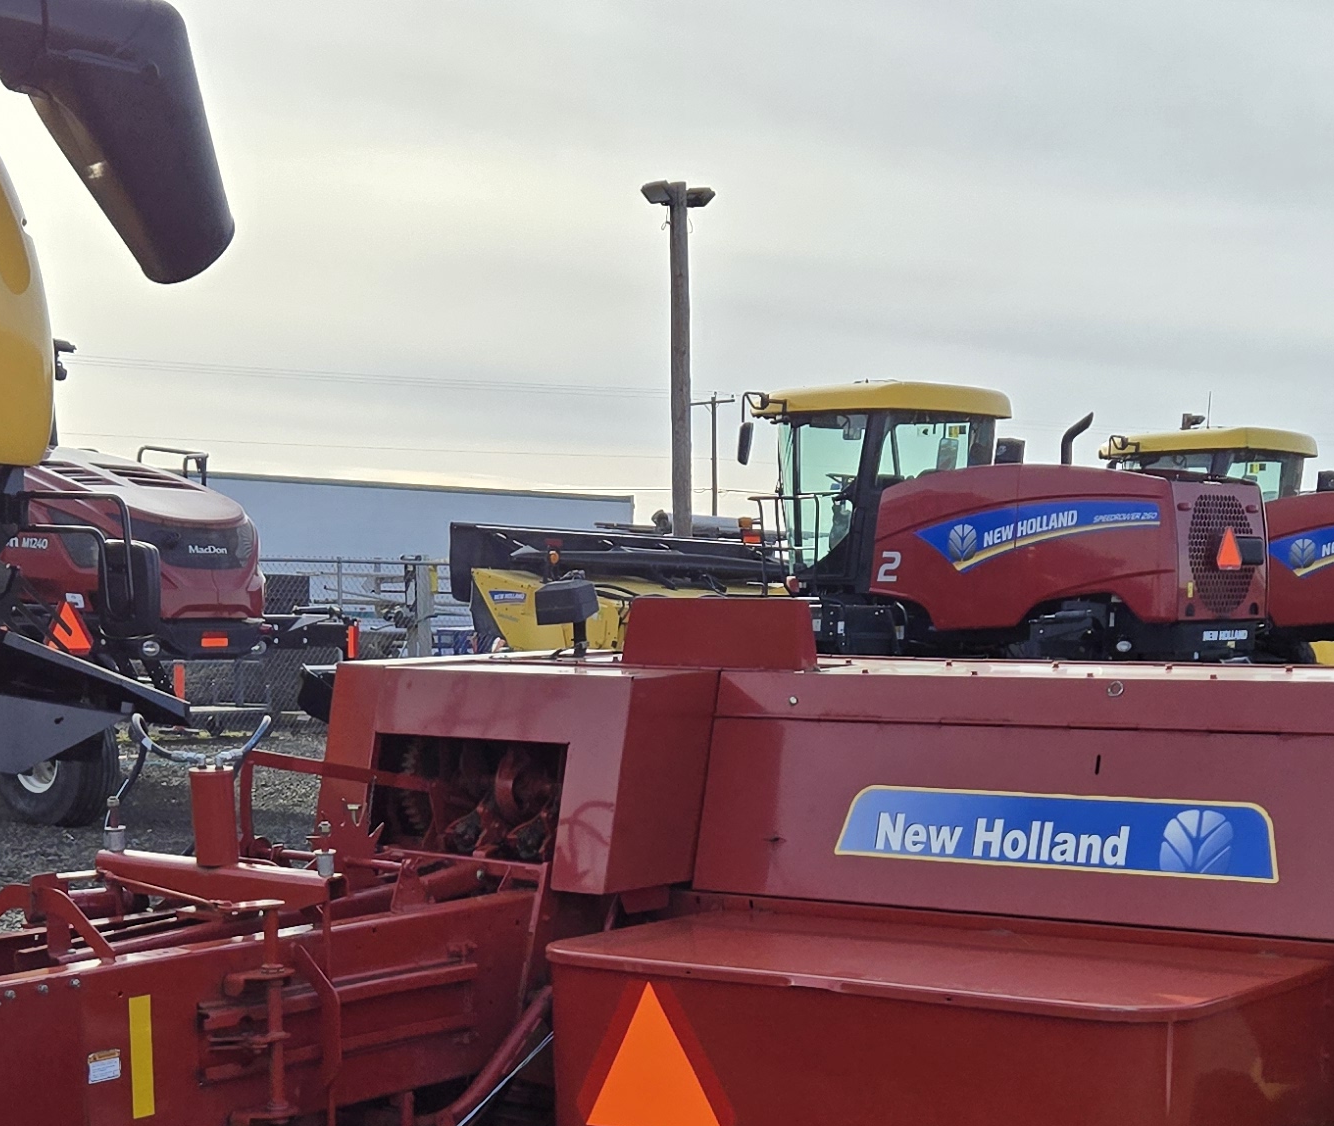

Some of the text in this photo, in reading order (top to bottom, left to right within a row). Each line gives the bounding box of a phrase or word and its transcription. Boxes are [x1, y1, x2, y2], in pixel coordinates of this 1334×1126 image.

[983, 510, 1078, 548] NEW HOLLAND
[21, 537, 48, 549] M1240
[188, 544, 228, 554] MacDon
[877, 551, 901, 582] 2
[1203, 630, 1218, 641] NEW
[875, 812, 1130, 866] New Holland
